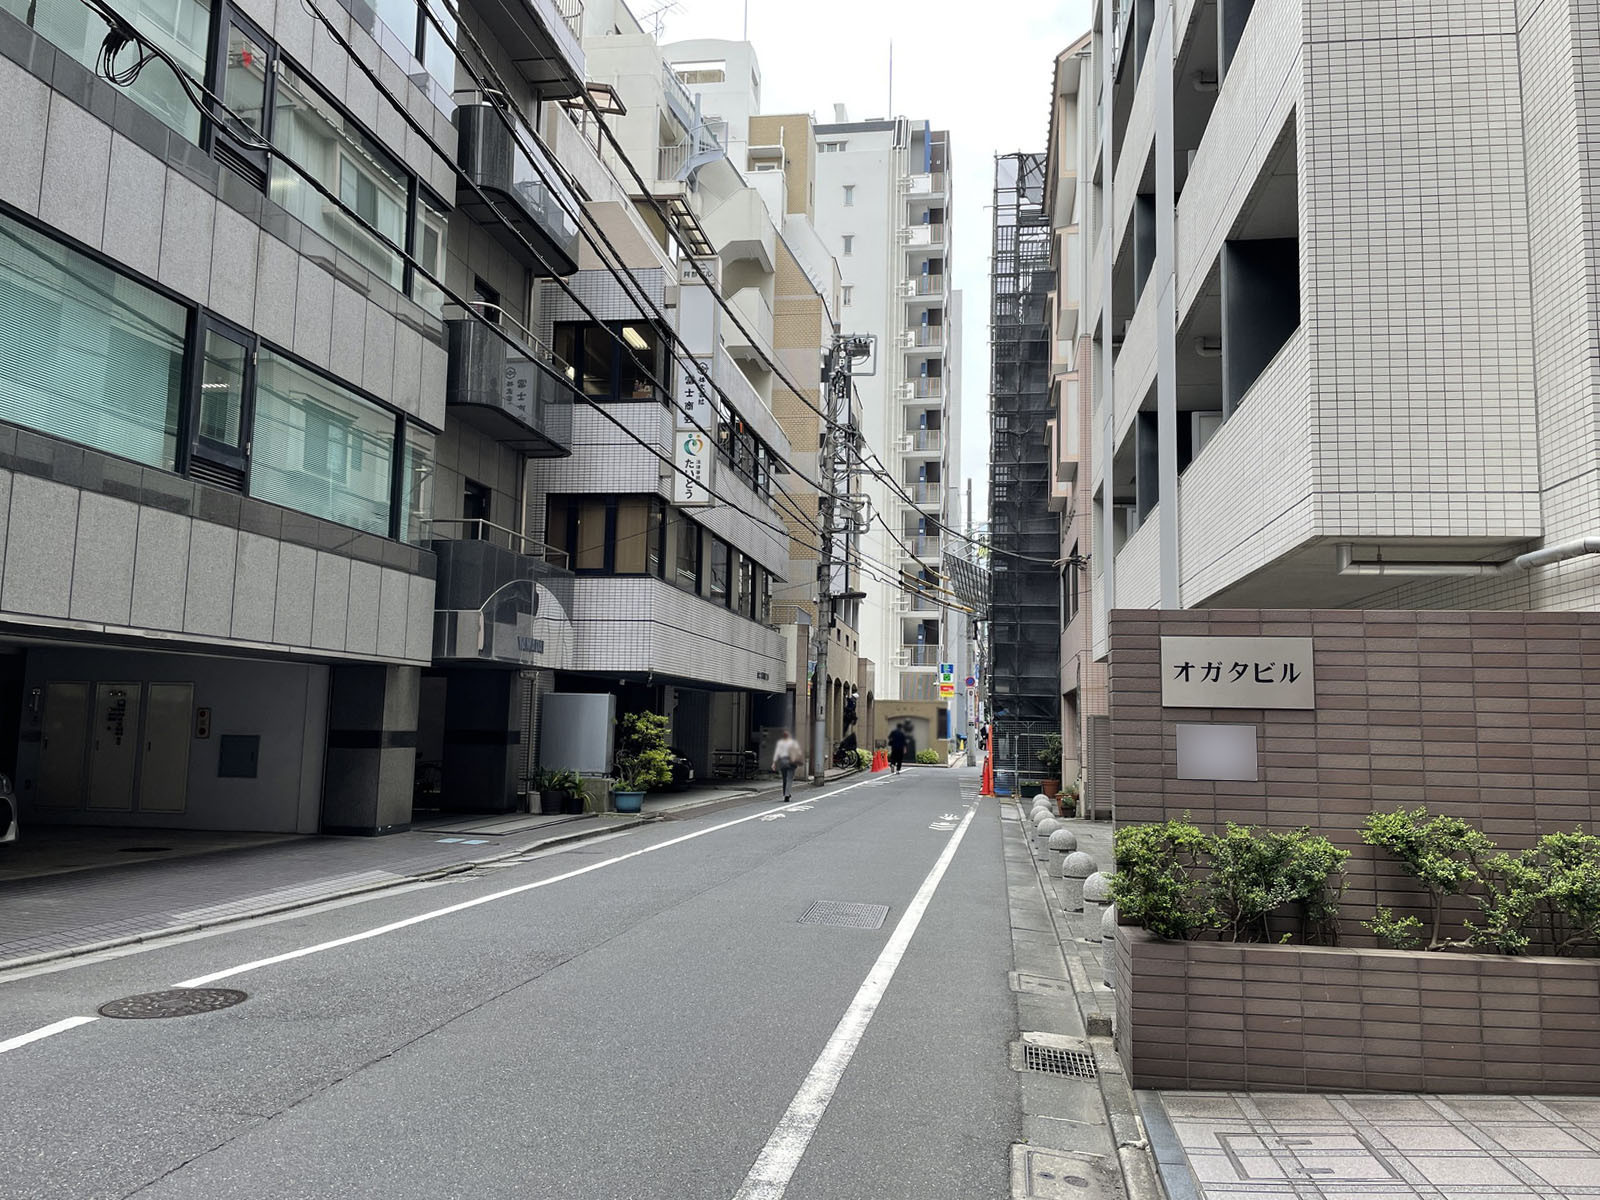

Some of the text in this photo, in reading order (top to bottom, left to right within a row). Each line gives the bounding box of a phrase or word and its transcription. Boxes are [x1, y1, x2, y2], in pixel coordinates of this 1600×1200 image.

[685, 458, 695, 499] たいとう
[1173, 661, 1302, 684] オガタビル
